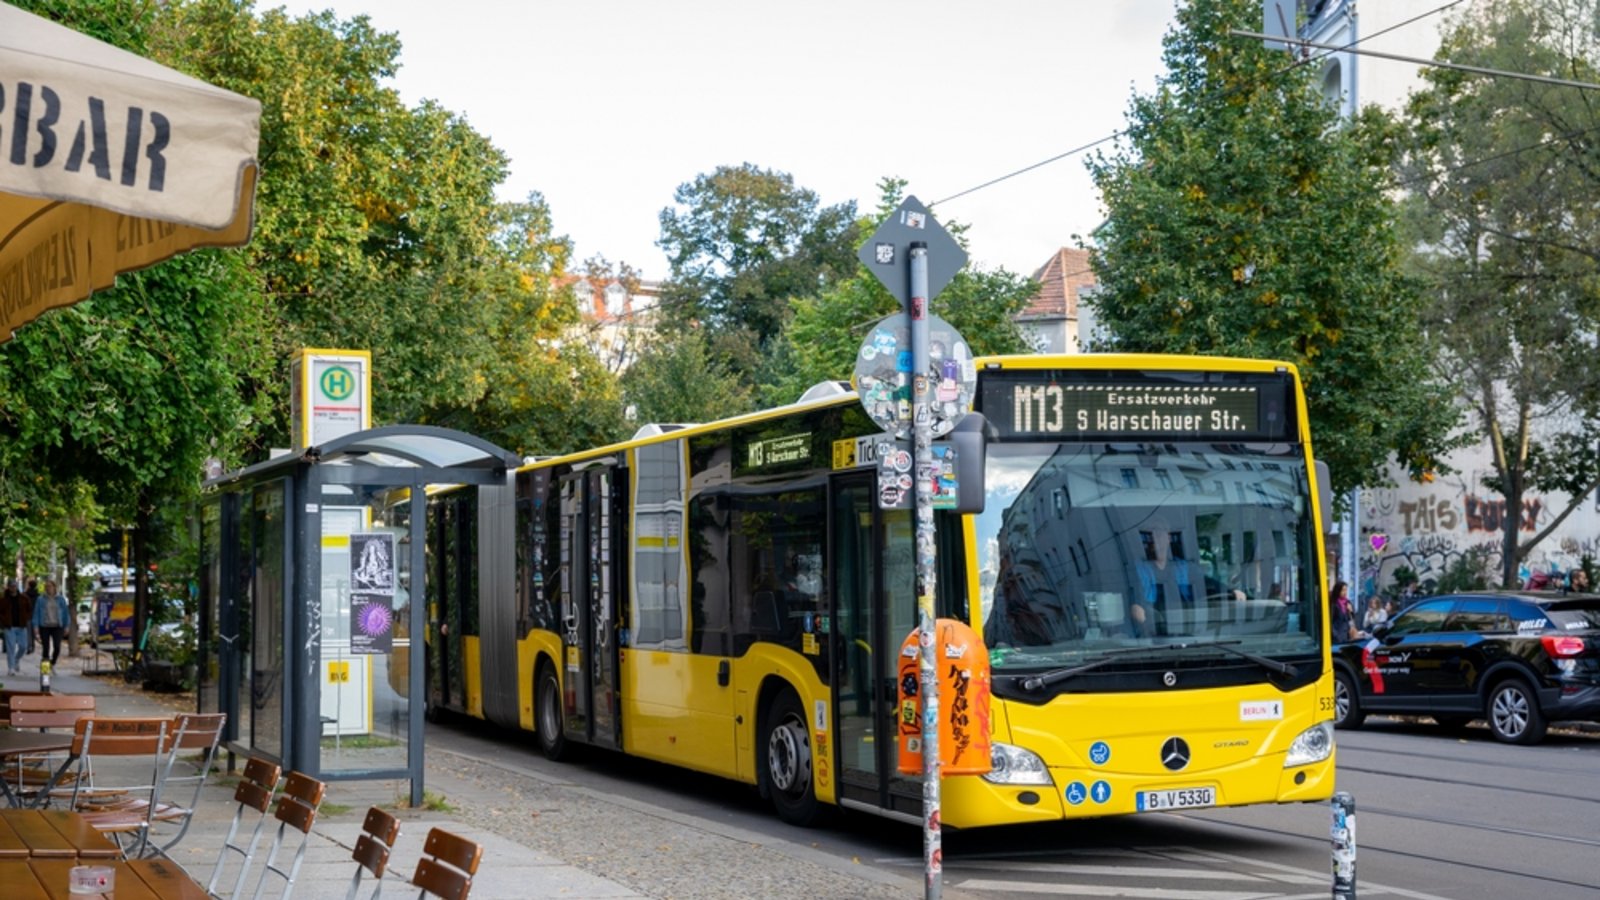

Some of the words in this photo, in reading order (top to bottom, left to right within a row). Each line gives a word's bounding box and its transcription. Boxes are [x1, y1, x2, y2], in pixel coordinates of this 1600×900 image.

[0, 80, 172, 192] BAR
[1013, 385, 1064, 433] M13
[1107, 392, 1217, 405] Ersatzverkehr
[1076, 410, 1089, 431] S
[1096, 410, 1203, 431] Warschauer
[1210, 410, 1247, 431] Str.
[858, 437, 881, 464] Tick
[1243, 706, 1267, 716] BERLIN
[1149, 792, 1159, 808] B
[1167, 791, 1176, 807] V
[1178, 788, 1211, 806] 5330
